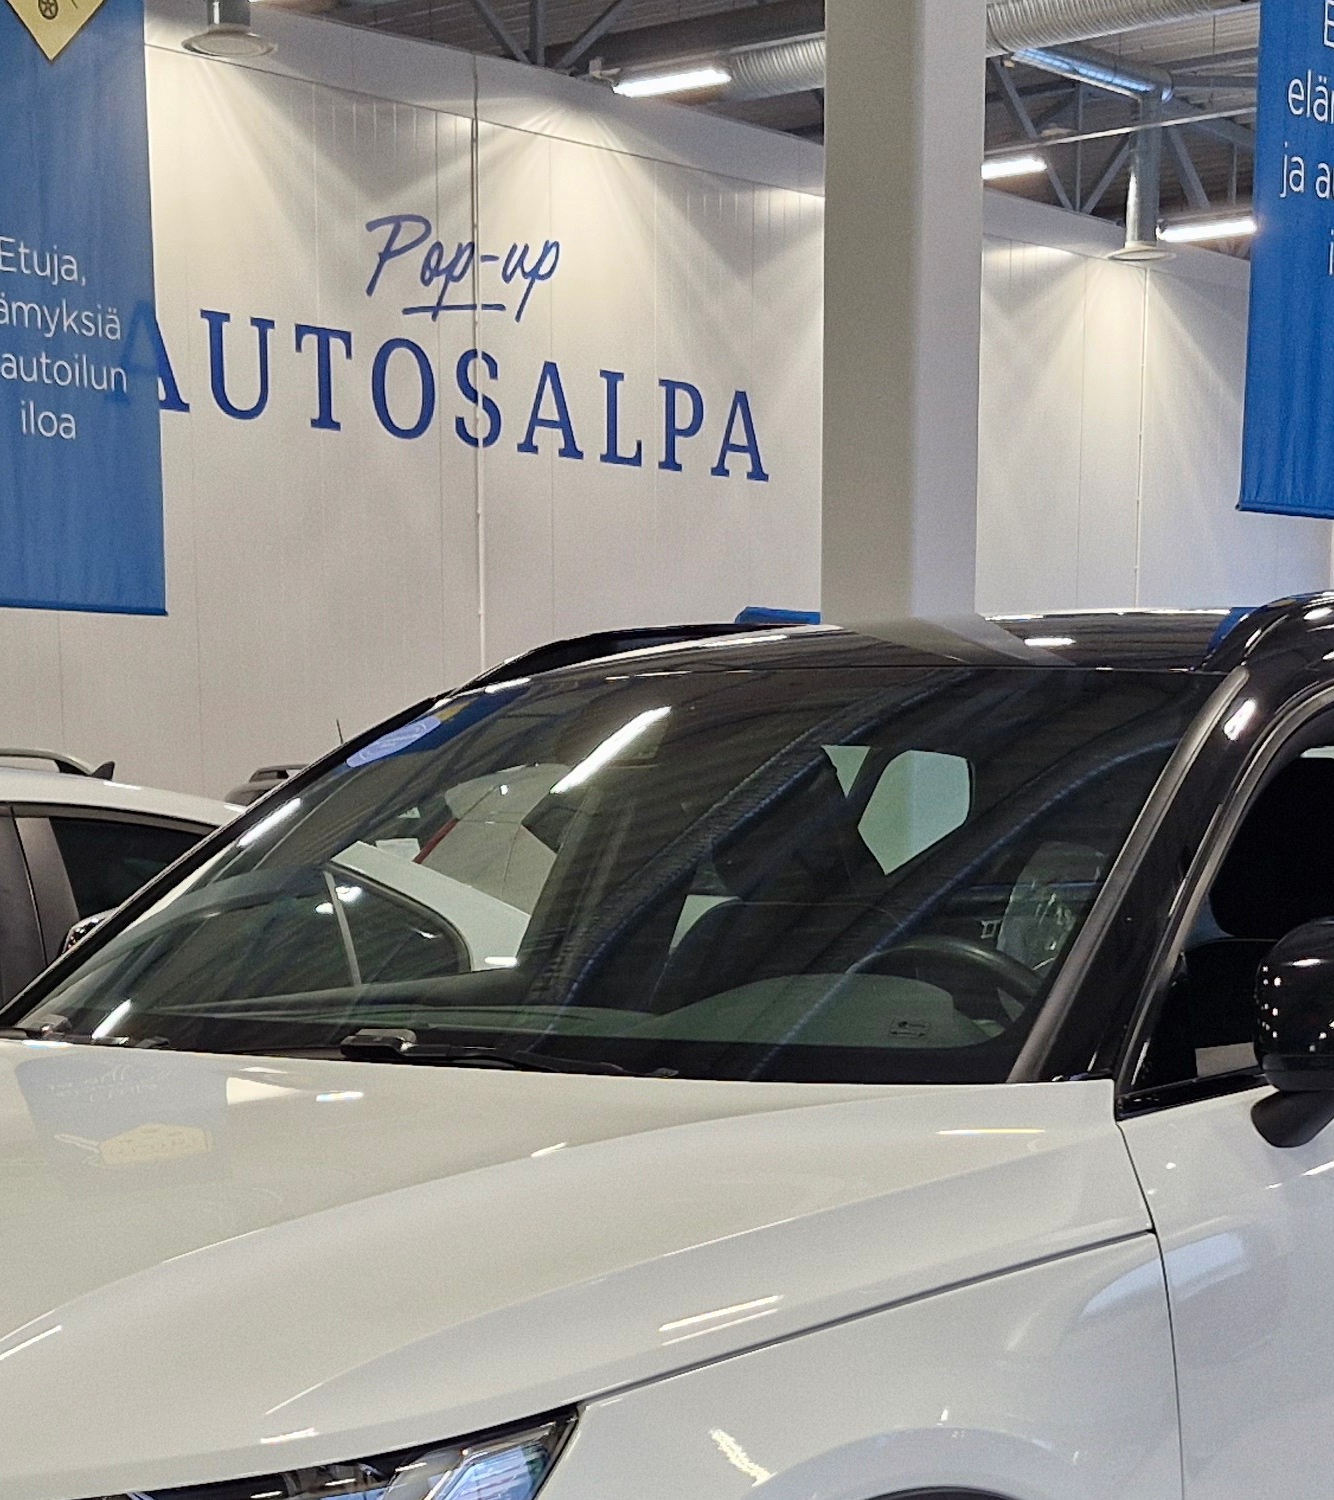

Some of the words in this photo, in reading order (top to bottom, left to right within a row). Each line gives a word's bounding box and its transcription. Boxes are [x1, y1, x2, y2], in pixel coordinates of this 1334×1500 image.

[1279, 142, 1306, 197] ja
[366, 213, 561, 322] Pop-up
[0, 350, 128, 395] autoilun
[20, 401, 77, 442] iloa
